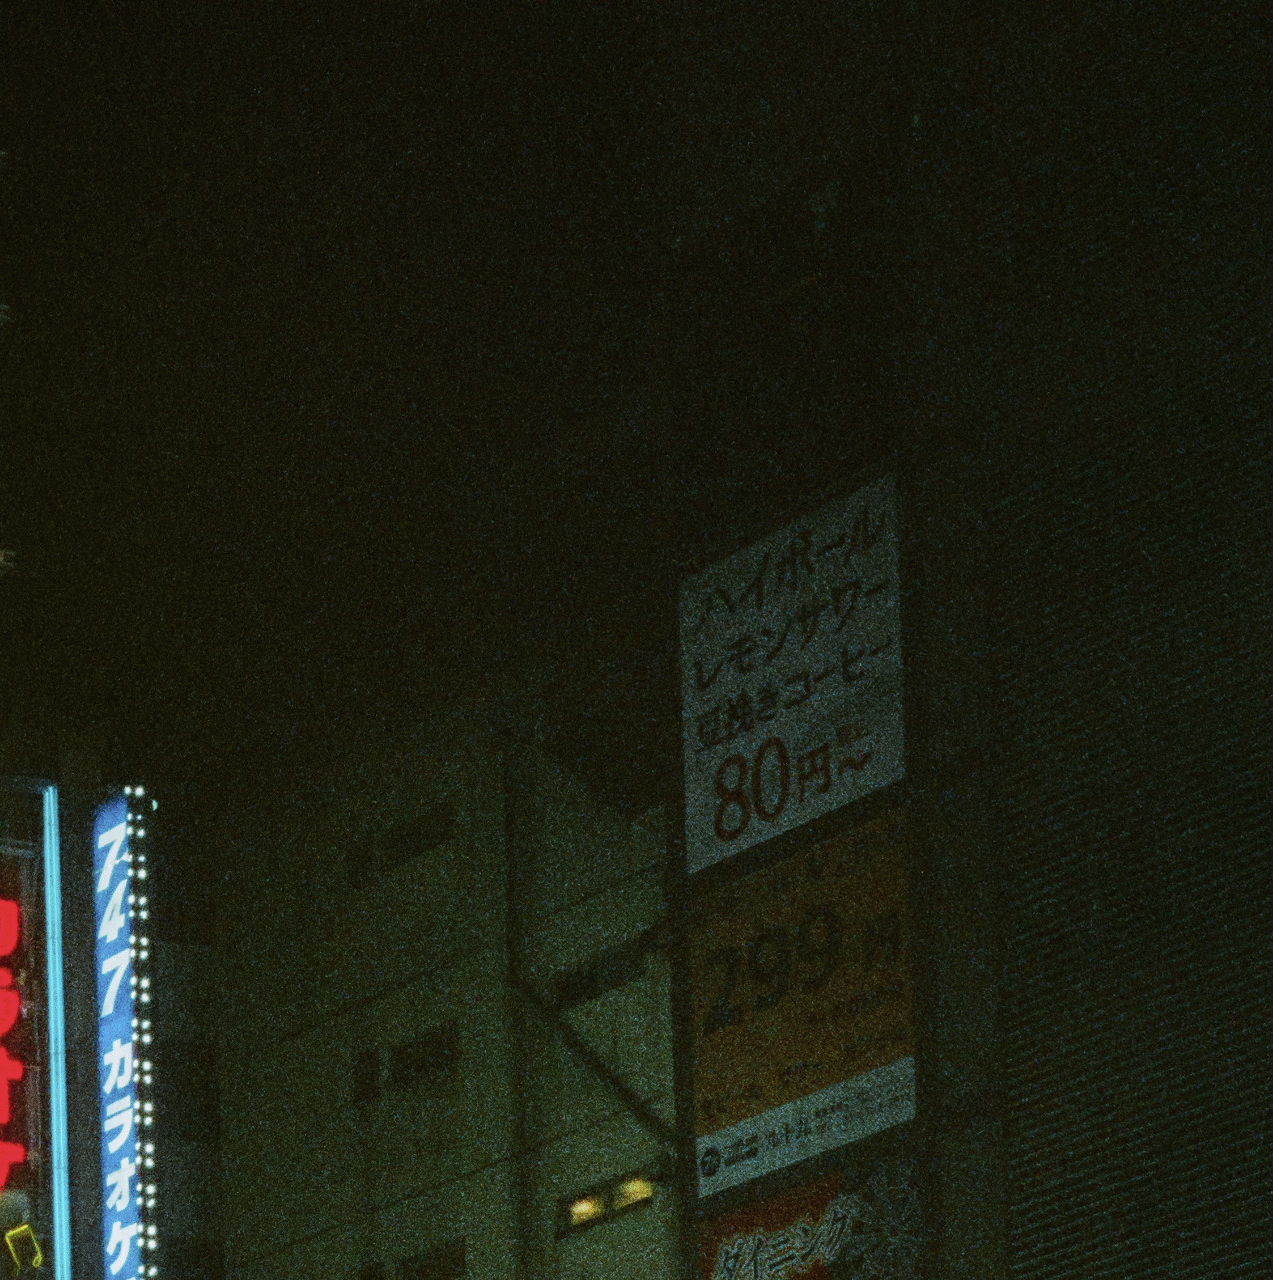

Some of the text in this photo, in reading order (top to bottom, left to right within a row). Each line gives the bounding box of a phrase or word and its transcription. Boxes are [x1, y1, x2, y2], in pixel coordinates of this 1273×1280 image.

[695, 579, 891, 691] レモンサワー
